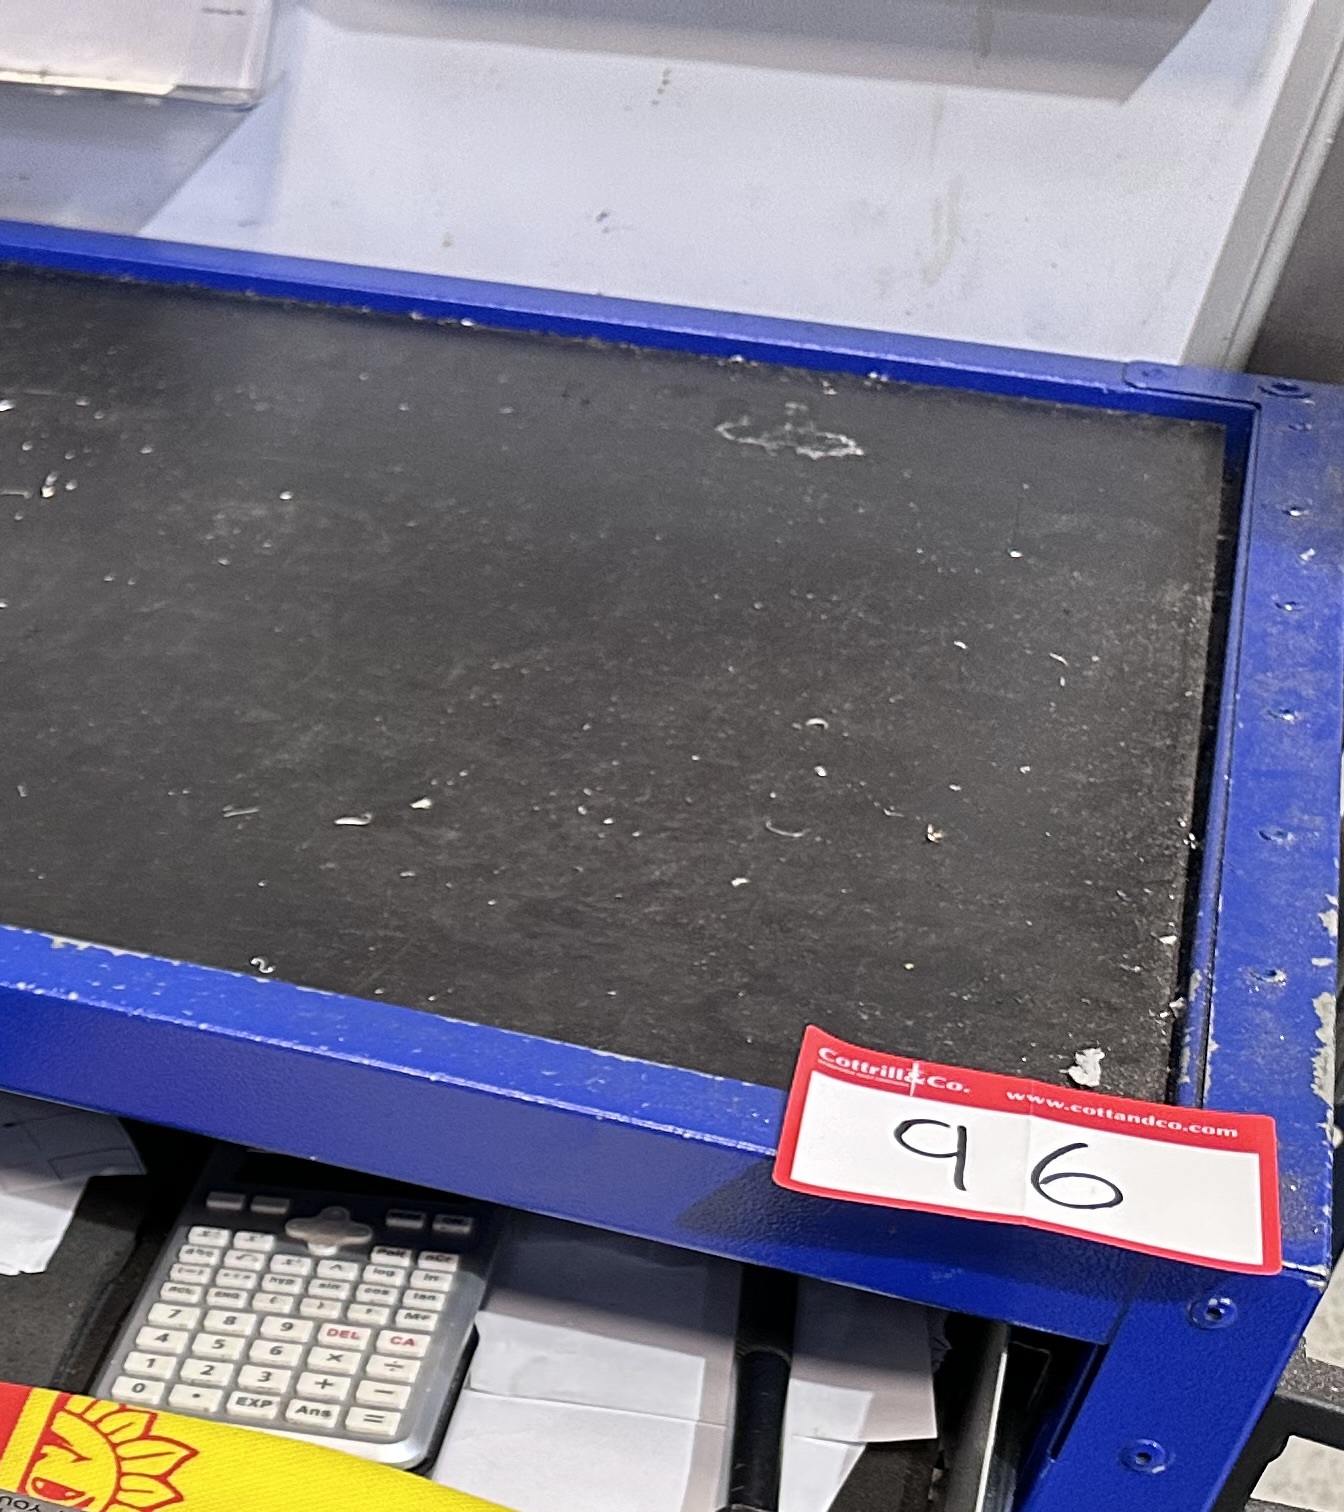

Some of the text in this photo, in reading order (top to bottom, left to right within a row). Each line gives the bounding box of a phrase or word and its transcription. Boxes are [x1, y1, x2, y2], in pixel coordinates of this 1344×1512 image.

[1006, 1088, 1240, 1139] www.cottandco.com
[893, 1118, 1124, 1210] 96
[154, 1332, 170, 1343] 4
[211, 1339, 226, 1349] 5
[269, 1345, 284, 1356] 6
[167, 1308, 416, 1347] 7 8 9 DEL CA
[146, 1358, 156, 1368] 1
[200, 1364, 215, 1376] 2
[257, 1371, 272, 1382] 3
[131, 1382, 146, 1393] 0
[235, 1396, 274, 1408] EXP
[295, 1405, 331, 1418] Ans
